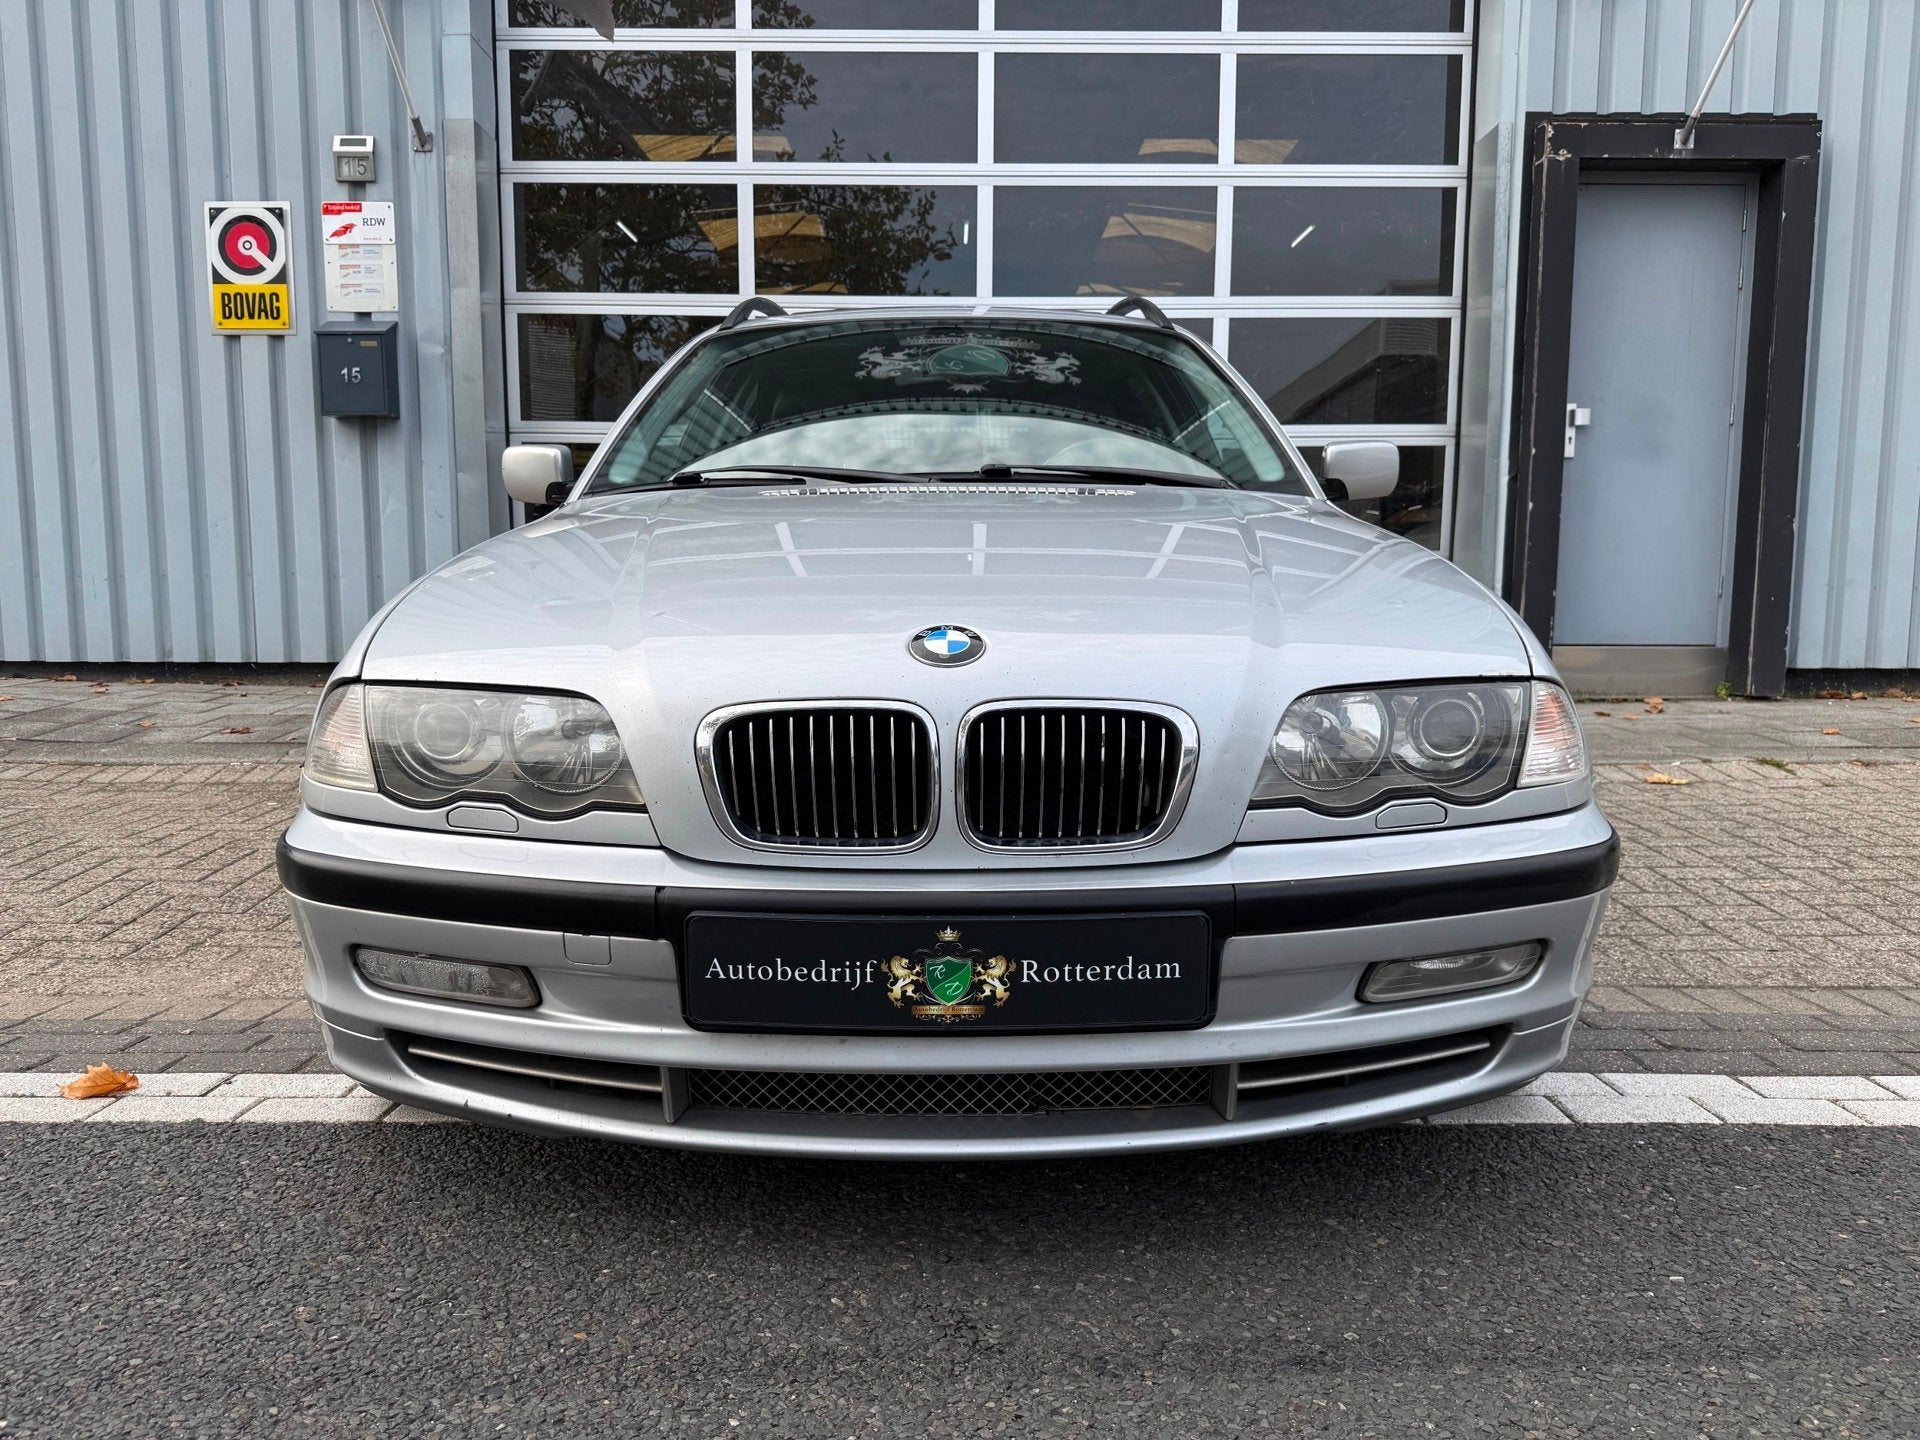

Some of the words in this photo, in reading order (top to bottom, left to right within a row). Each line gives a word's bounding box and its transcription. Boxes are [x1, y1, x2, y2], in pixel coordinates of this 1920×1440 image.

[344, 158, 367, 176] 15
[362, 217, 386, 227] RDW
[221, 292, 281, 321] BOVAG
[340, 367, 361, 383] 15
[704, 957, 878, 991] Autobedrijf
[1020, 955, 1182, 983] Rotterdam
